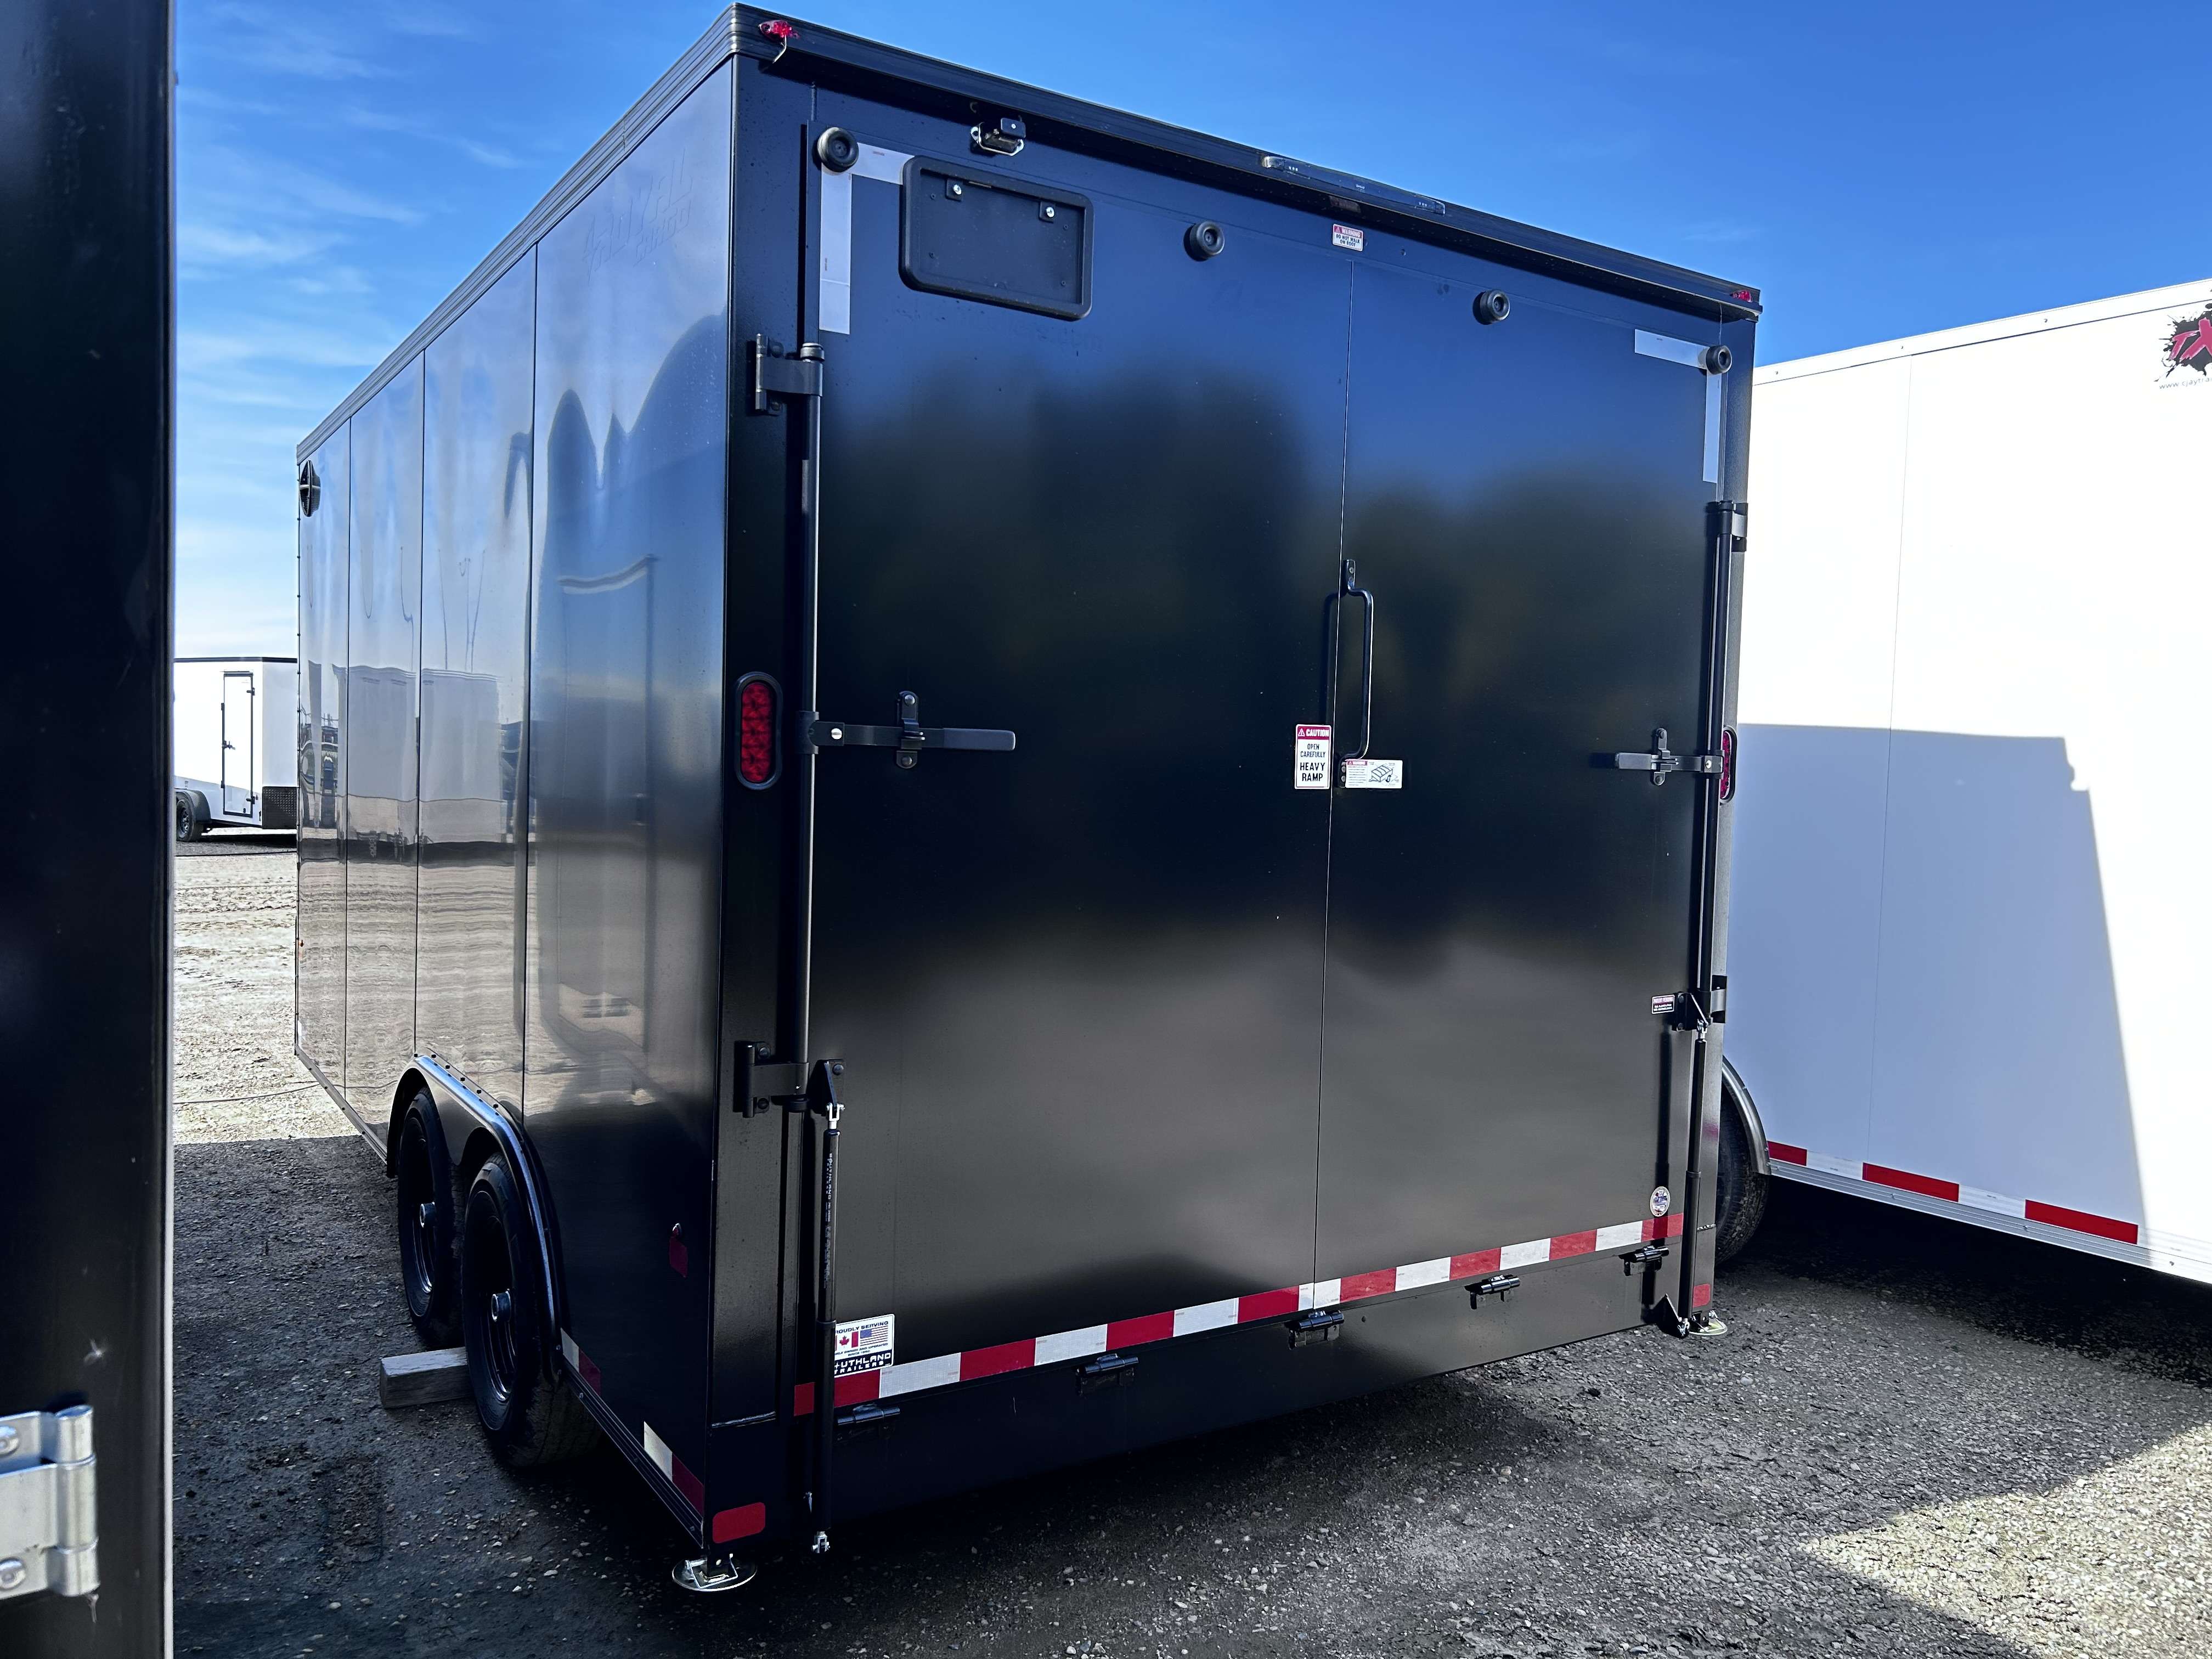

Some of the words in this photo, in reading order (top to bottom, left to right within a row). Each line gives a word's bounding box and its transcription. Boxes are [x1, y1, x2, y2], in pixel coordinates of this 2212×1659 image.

[1342, 228, 1361, 238] WARNING
[1306, 729, 1329, 737] CAUTION
[1300, 762, 1325, 771] HEAVY
[1302, 773, 1323, 782] RAMP
[861, 1321, 889, 1329] SERVING
